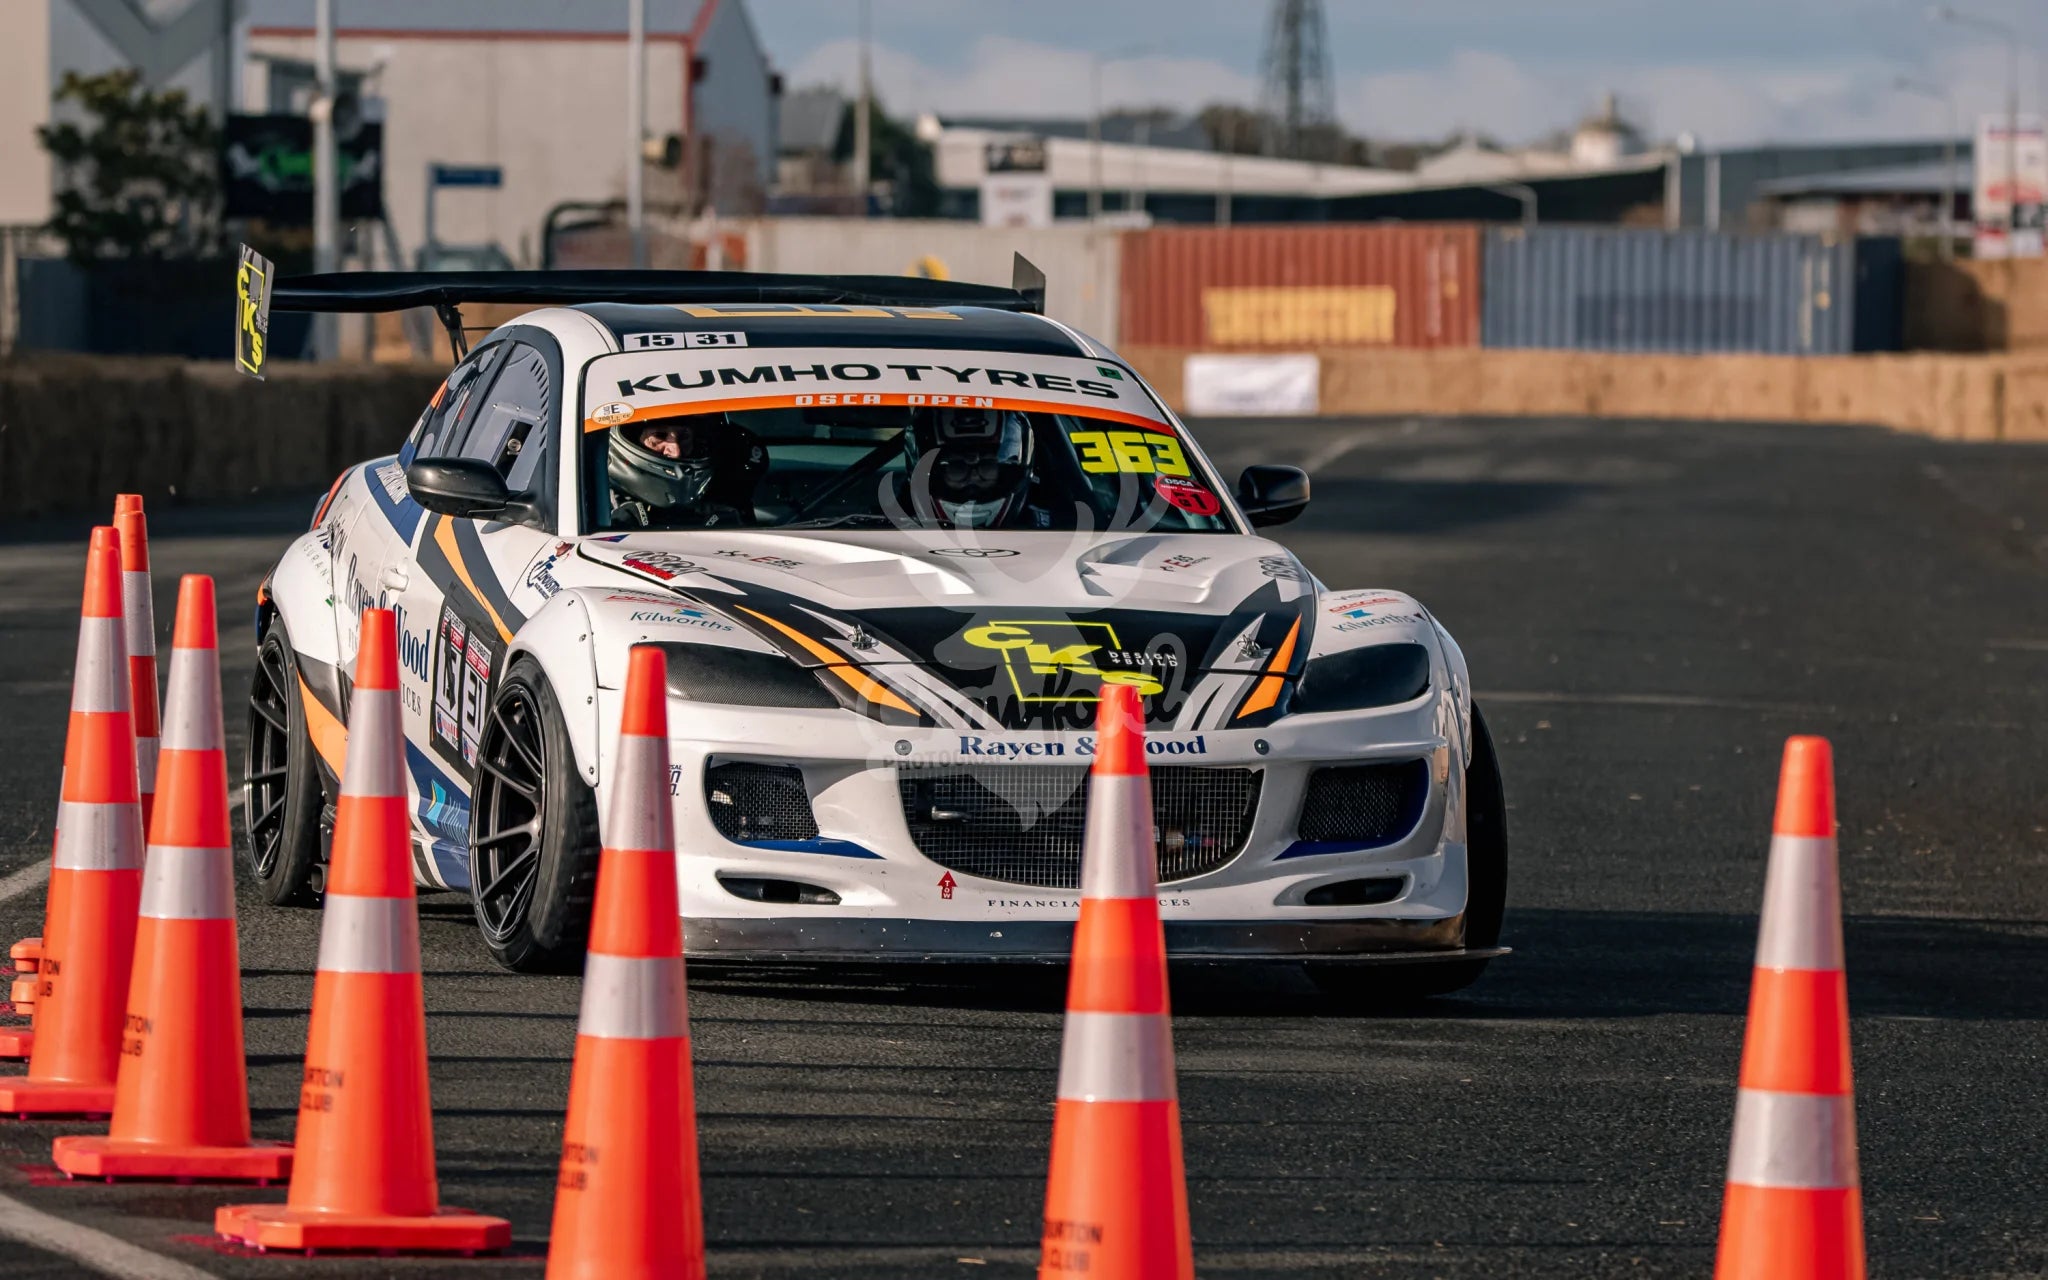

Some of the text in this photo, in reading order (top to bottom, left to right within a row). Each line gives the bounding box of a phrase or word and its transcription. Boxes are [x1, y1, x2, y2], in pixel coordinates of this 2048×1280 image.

[237, 267, 263, 366] CKS
[633, 333, 737, 347] 15 31
[795, 394, 994, 408] OSCA OPEN
[1069, 430, 1191, 477] 363
[630, 611, 735, 632] Kilworths
[1331, 613, 1417, 633] Kilworths
[963, 625, 1164, 696] CKS
[959, 735, 1208, 761] Rayen & ood
[944, 879, 952, 899] TOW
[988, 899, 1081, 908] FINANCIA
